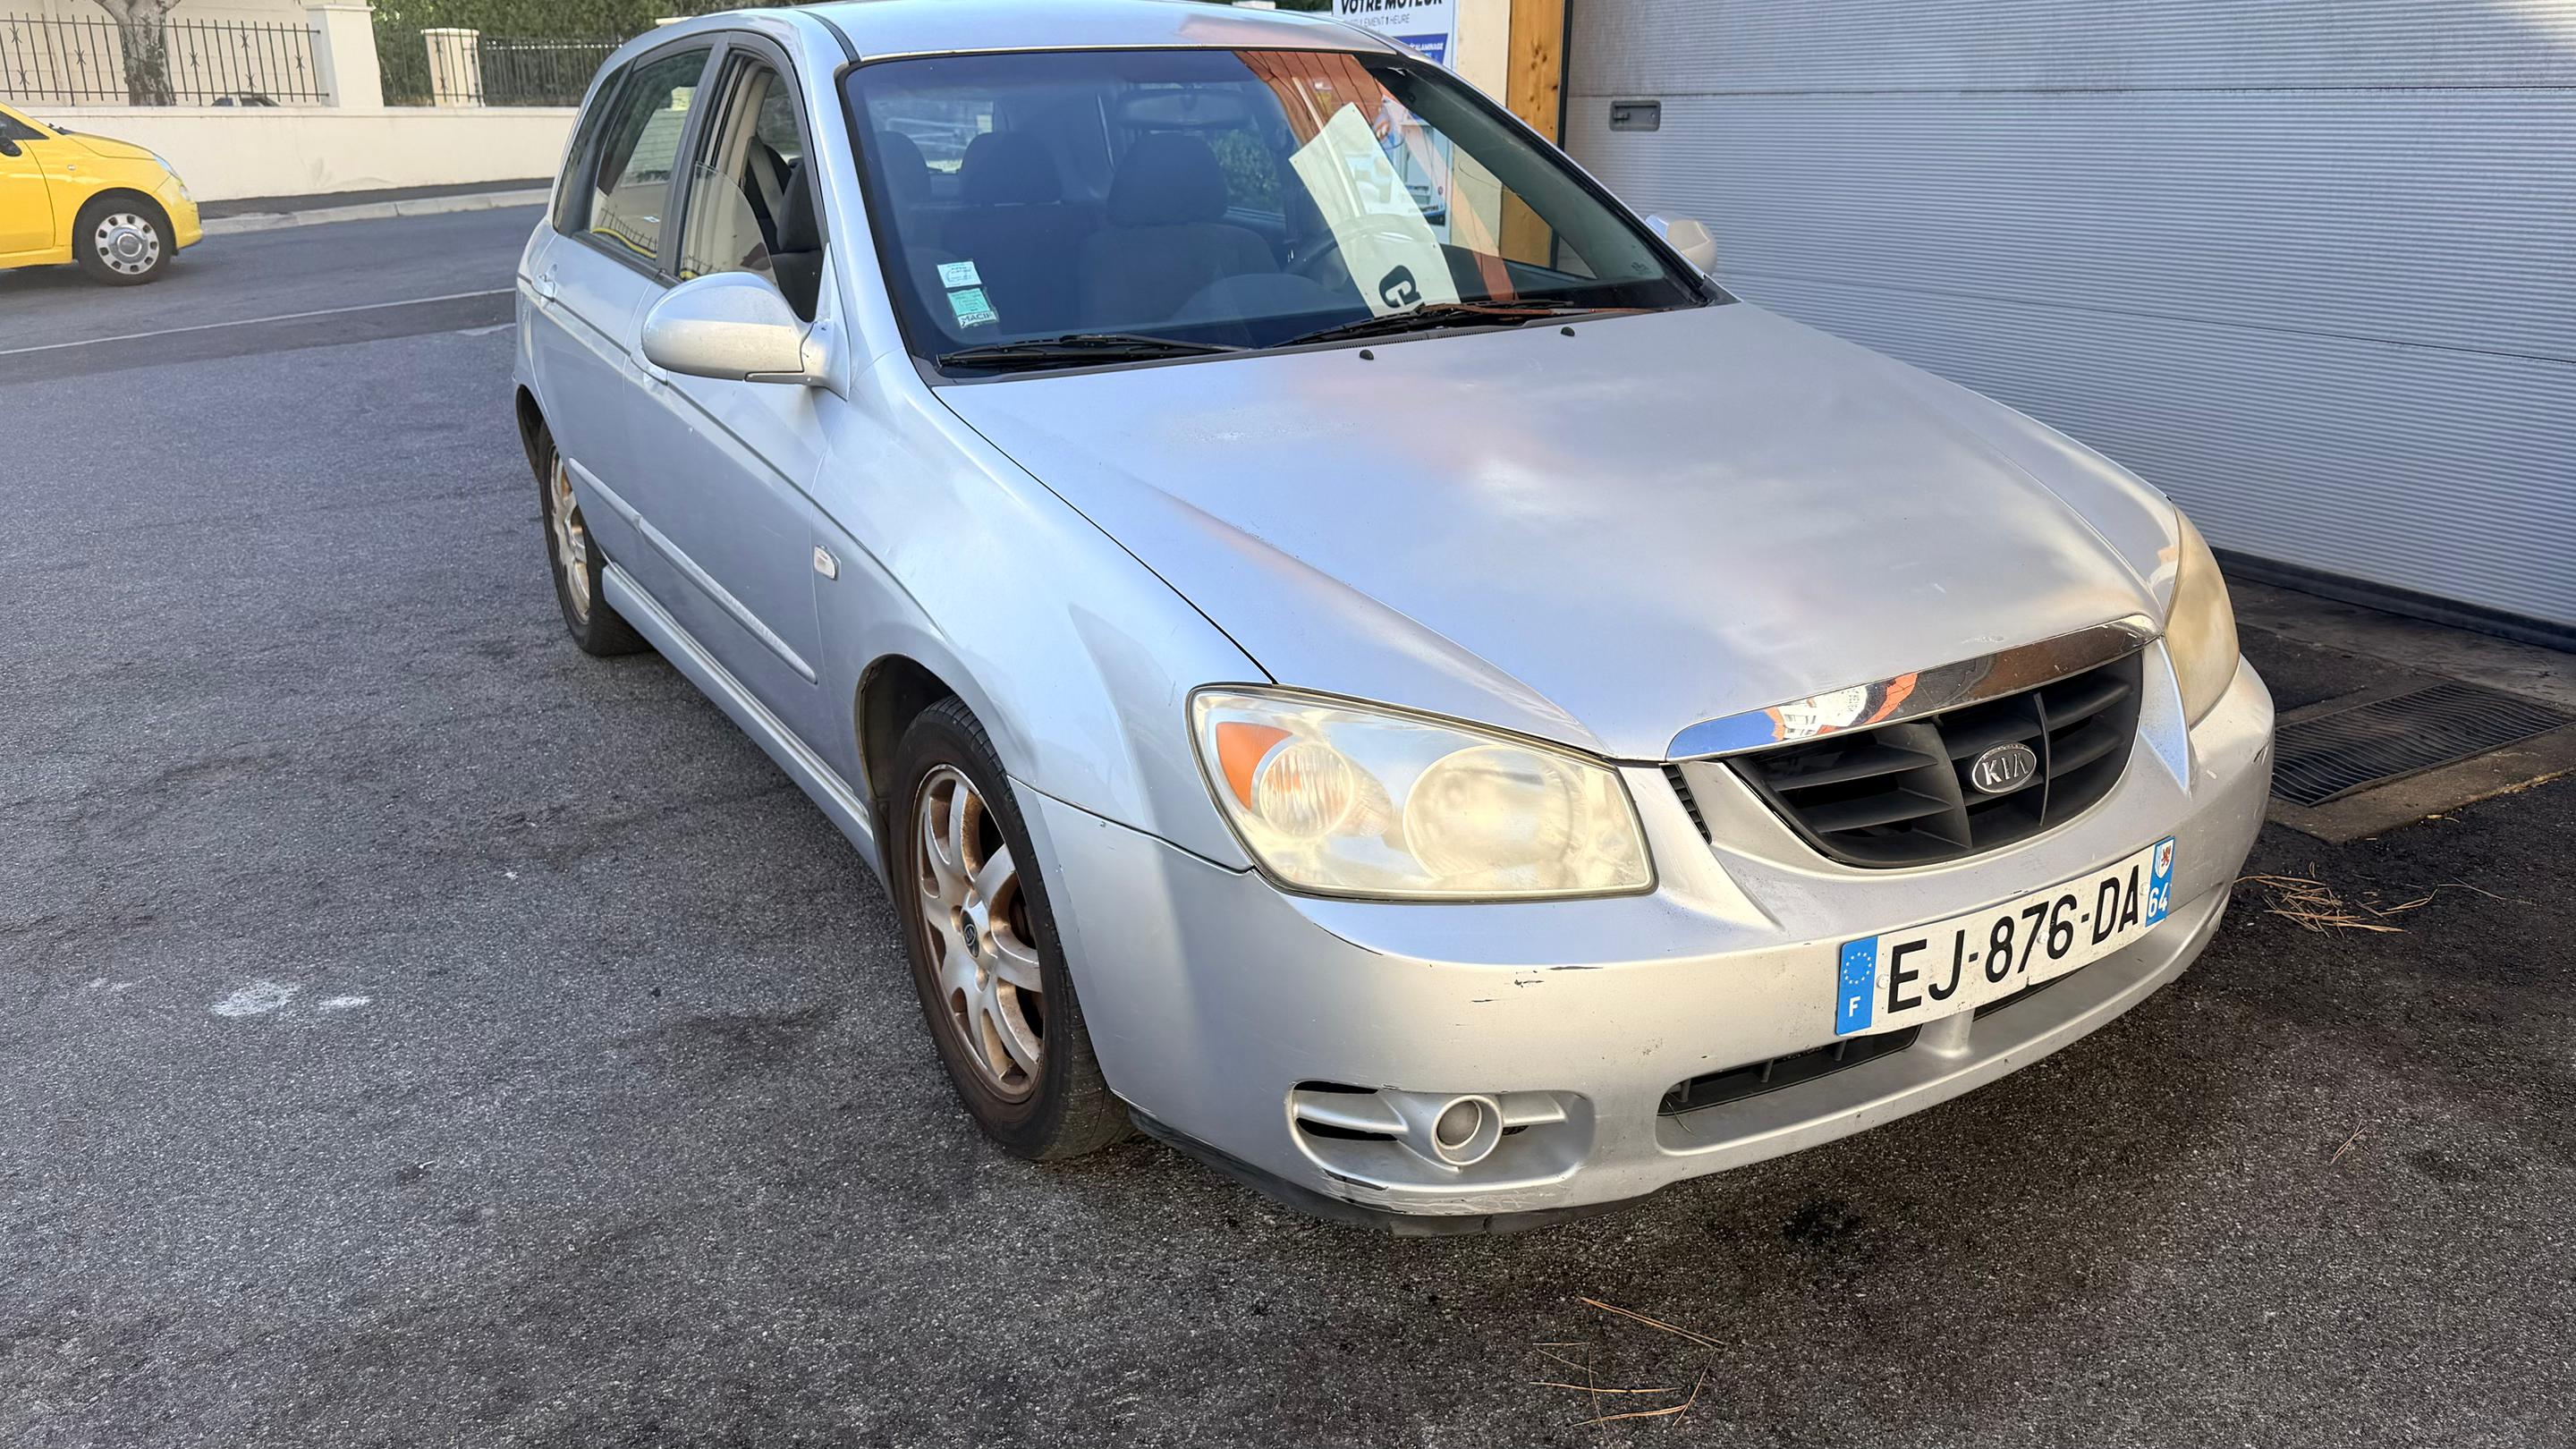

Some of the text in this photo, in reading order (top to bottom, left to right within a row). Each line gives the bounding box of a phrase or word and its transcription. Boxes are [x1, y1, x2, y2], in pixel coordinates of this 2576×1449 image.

[1385, 0, 1443, 10] MOT
[1982, 753, 2029, 785] KIA
[1848, 865, 2169, 1017] F EJ-876-DA 64
